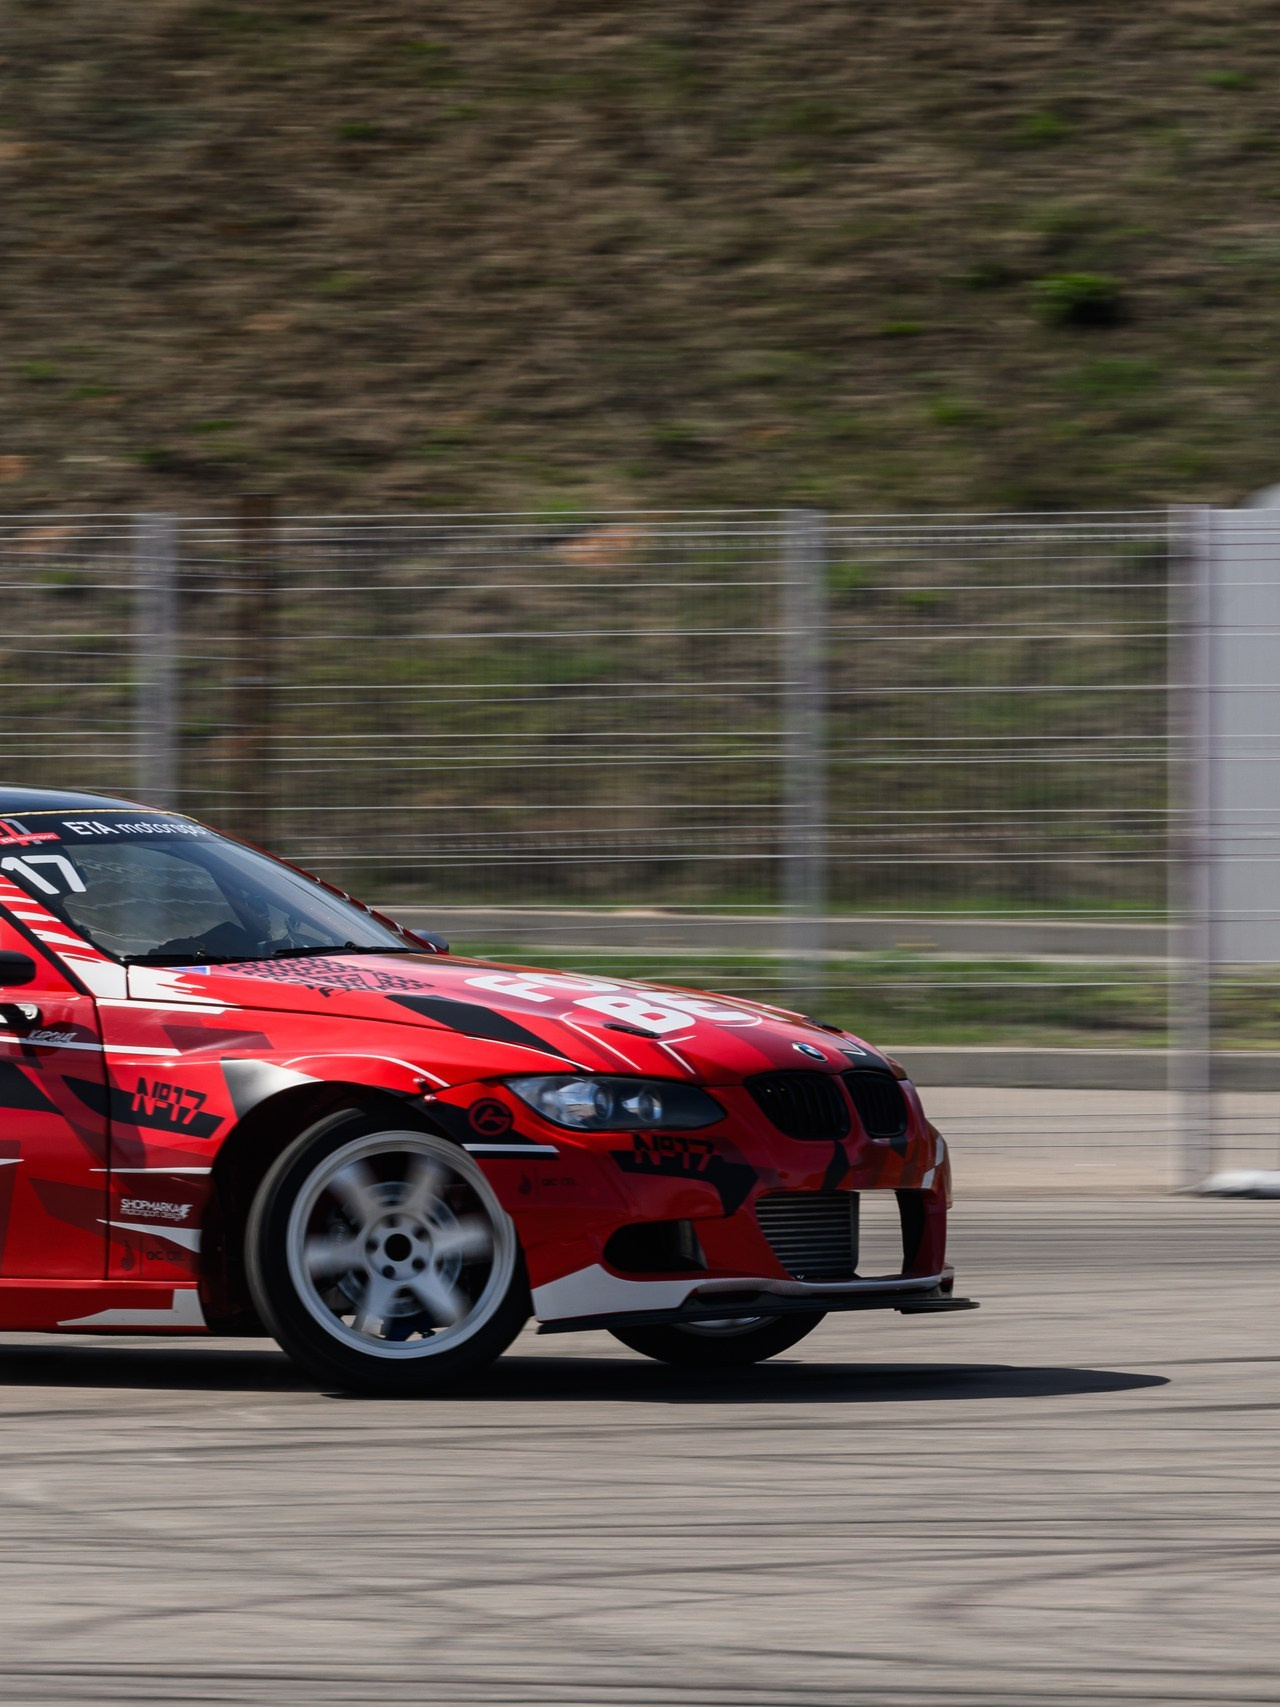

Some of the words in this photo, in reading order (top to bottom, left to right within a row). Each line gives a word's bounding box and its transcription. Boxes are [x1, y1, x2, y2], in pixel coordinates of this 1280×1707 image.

[62, 821, 116, 835] ETA
[114, 821, 208, 837] motorspo
[1, 855, 87, 895] 17
